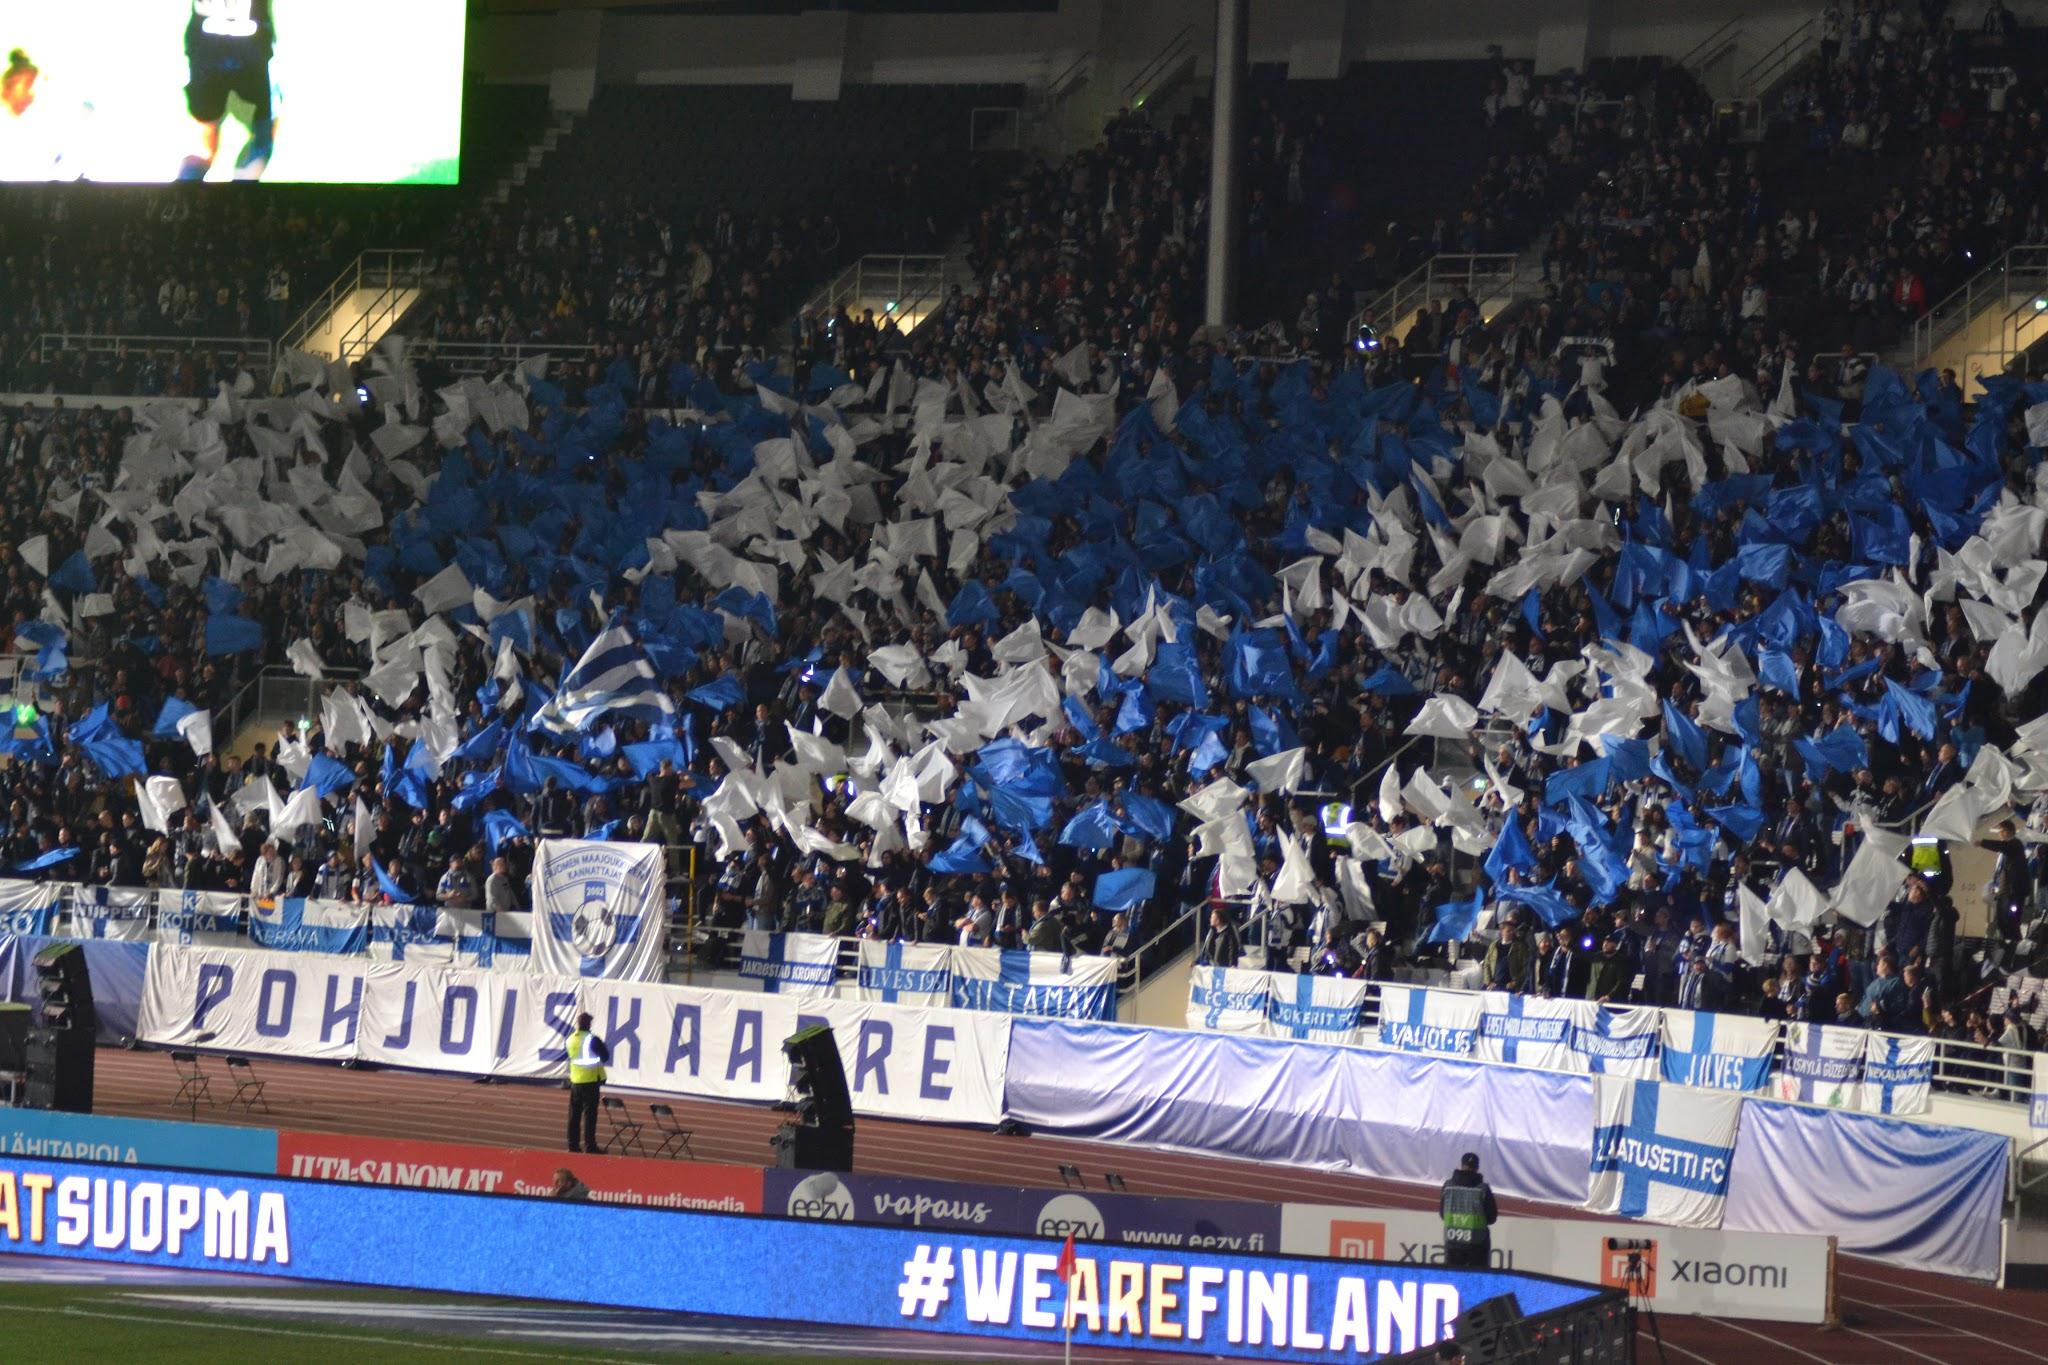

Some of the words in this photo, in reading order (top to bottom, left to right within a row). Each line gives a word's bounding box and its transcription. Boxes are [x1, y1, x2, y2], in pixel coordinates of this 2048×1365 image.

[160, 912, 217, 932] KOTKA
[861, 968, 918, 991] ILVES
[1276, 1007, 1336, 1026] JOKERIT
[193, 964, 955, 1100] POHJOISKAARE
[1700, 1157, 1726, 1184] FC
[647, 1192, 745, 1213] uutismedia
[792, 1198, 849, 1221] eezy
[873, 1193, 993, 1226] vapaus
[1041, 1218, 1100, 1240] eezy
[1452, 1213, 1470, 1226] TV
[1671, 1260, 1787, 1289] xiaomi
